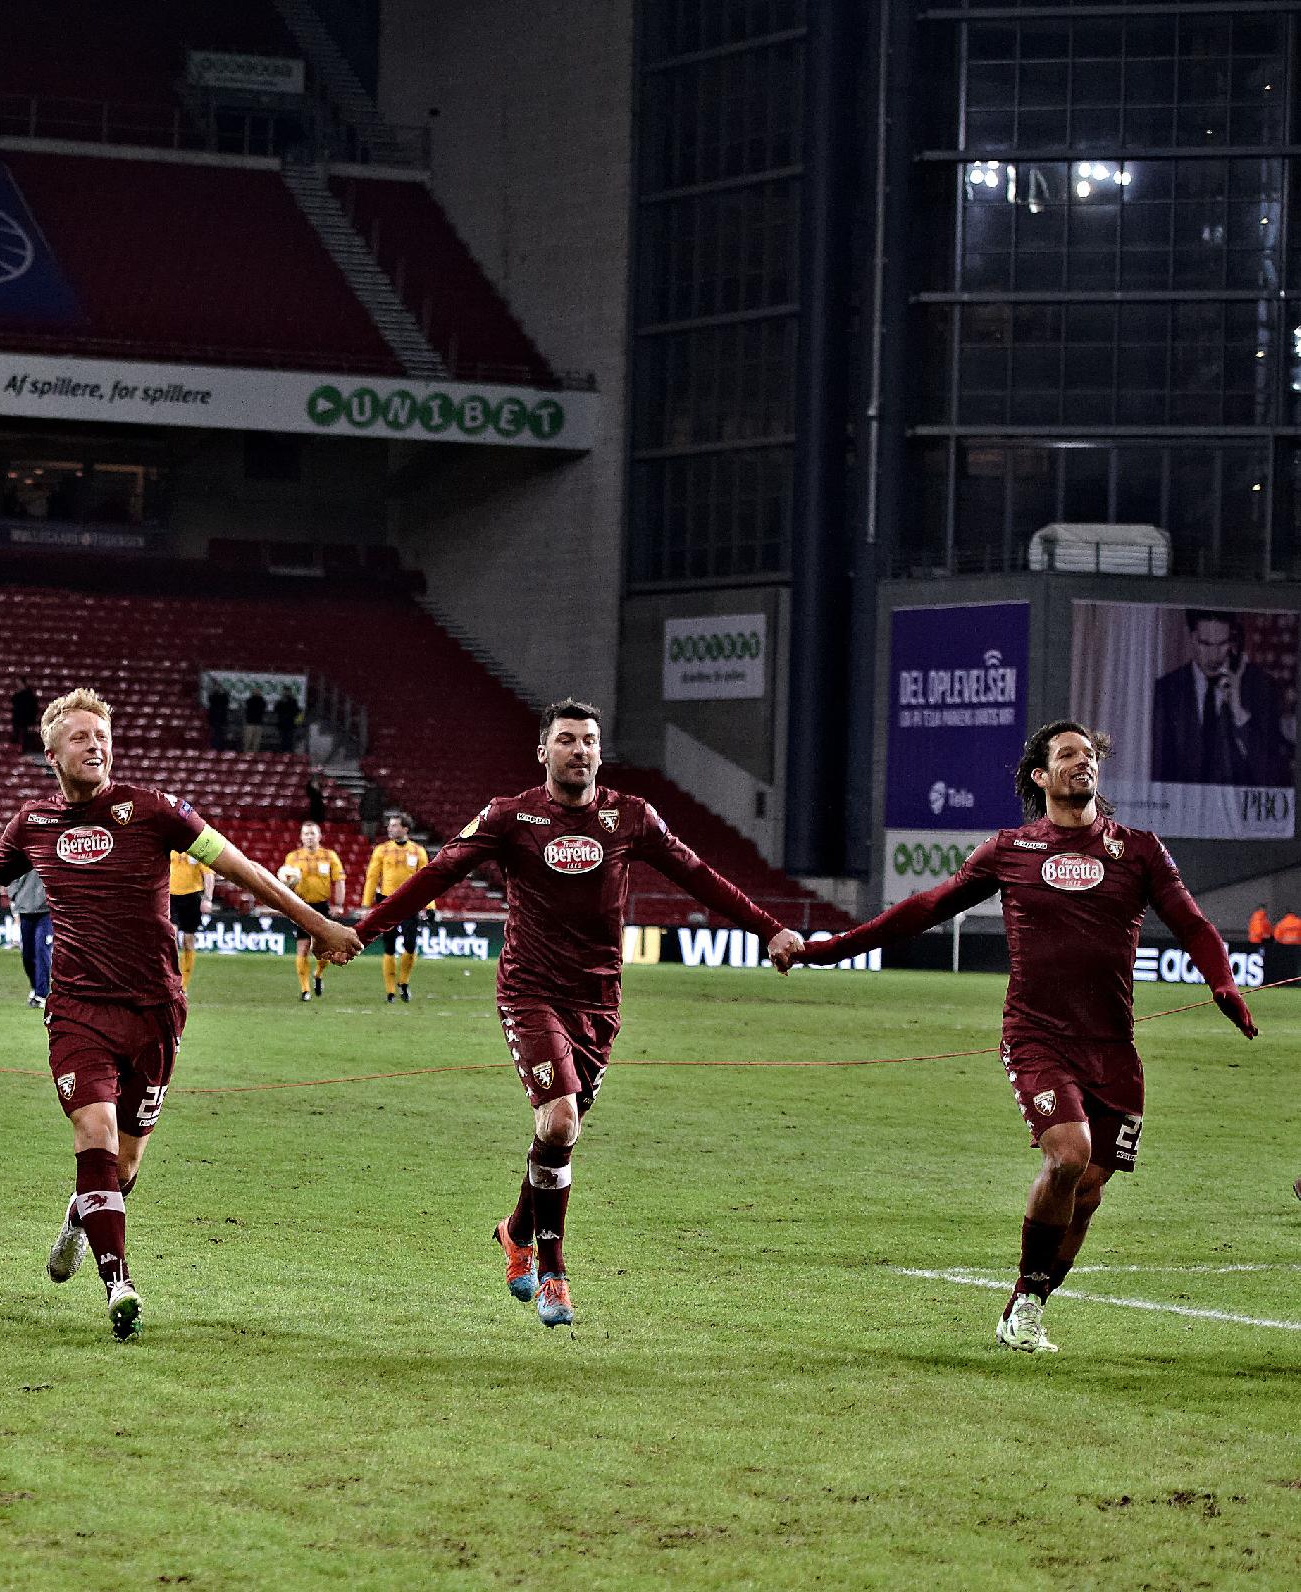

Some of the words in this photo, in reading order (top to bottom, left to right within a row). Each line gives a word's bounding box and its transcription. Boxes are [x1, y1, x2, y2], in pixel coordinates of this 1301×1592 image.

[3, 374, 29, 397] Af
[29, 376, 104, 401] spillere,
[109, 380, 138, 404] for
[141, 383, 212, 405] spillere
[347, 387, 563, 439] UNIBET
[899, 669, 925, 705] DEL
[59, 834, 109, 856] Beretta
[547, 844, 600, 864] Beretta
[1044, 860, 1100, 881] Beretta
